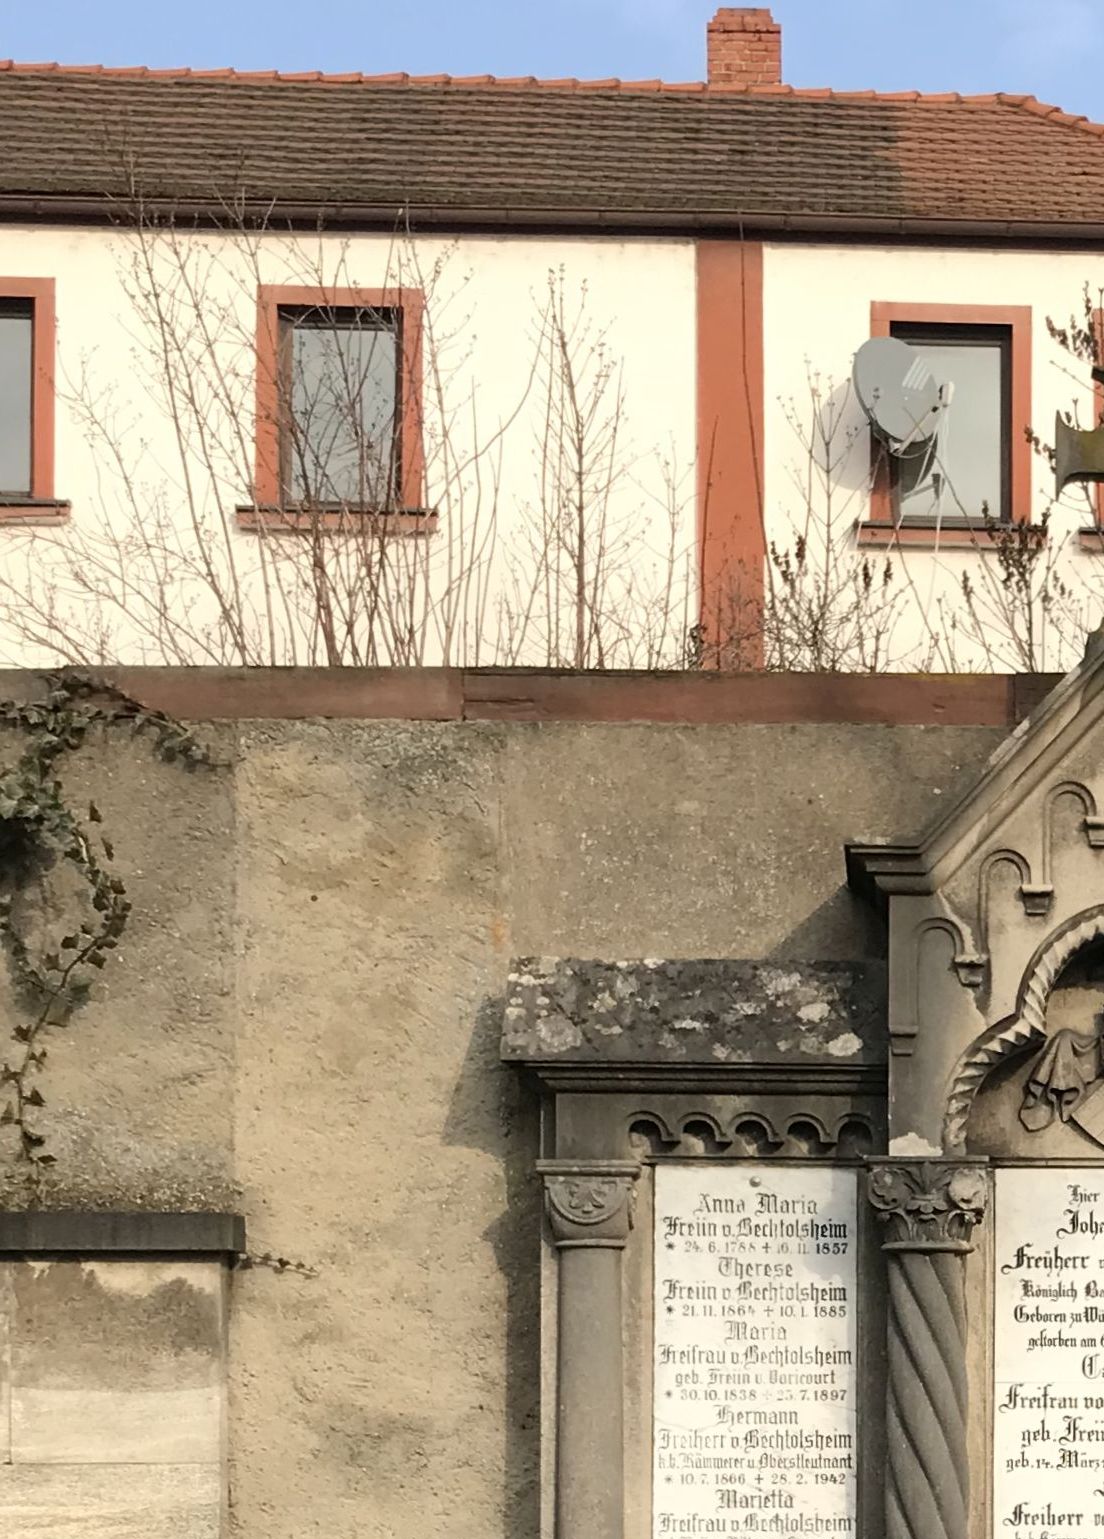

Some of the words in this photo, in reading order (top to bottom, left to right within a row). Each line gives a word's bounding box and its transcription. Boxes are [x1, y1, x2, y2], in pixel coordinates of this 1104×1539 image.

[693, 1193, 746, 1215] Anna
[754, 1192, 818, 1217] Maria
[1067, 1185, 1100, 1207] Hier
[662, 1216, 718, 1240] Freiin
[816, 1242, 848, 1255] 1857
[718, 1256, 793, 1279] Therese
[662, 1279, 718, 1304] Freiin
[1020, 1280, 1077, 1302] Königlich
[814, 1304, 847, 1318] 1885
[1014, 1305, 1066, 1323] Geboren
[1070, 1312, 1083, 1328] zu
[724, 1320, 788, 1343] Maria
[1080, 1336, 1097, 1348] am
[658, 1344, 728, 1366] Freifrau
[814, 1389, 848, 1402] 1897
[998, 1384, 1078, 1415] Freifrau
[713, 1405, 799, 1432] Hermann
[657, 1428, 727, 1451] Freiherr
[1021, 1418, 1057, 1448] geb.
[1006, 1450, 1034, 1473] geb.
[815, 1474, 847, 1486] 1942
[715, 1489, 795, 1512] Marietta
[657, 1512, 727, 1536] Freifrau
[1002, 1502, 1083, 1528] Freiherr
